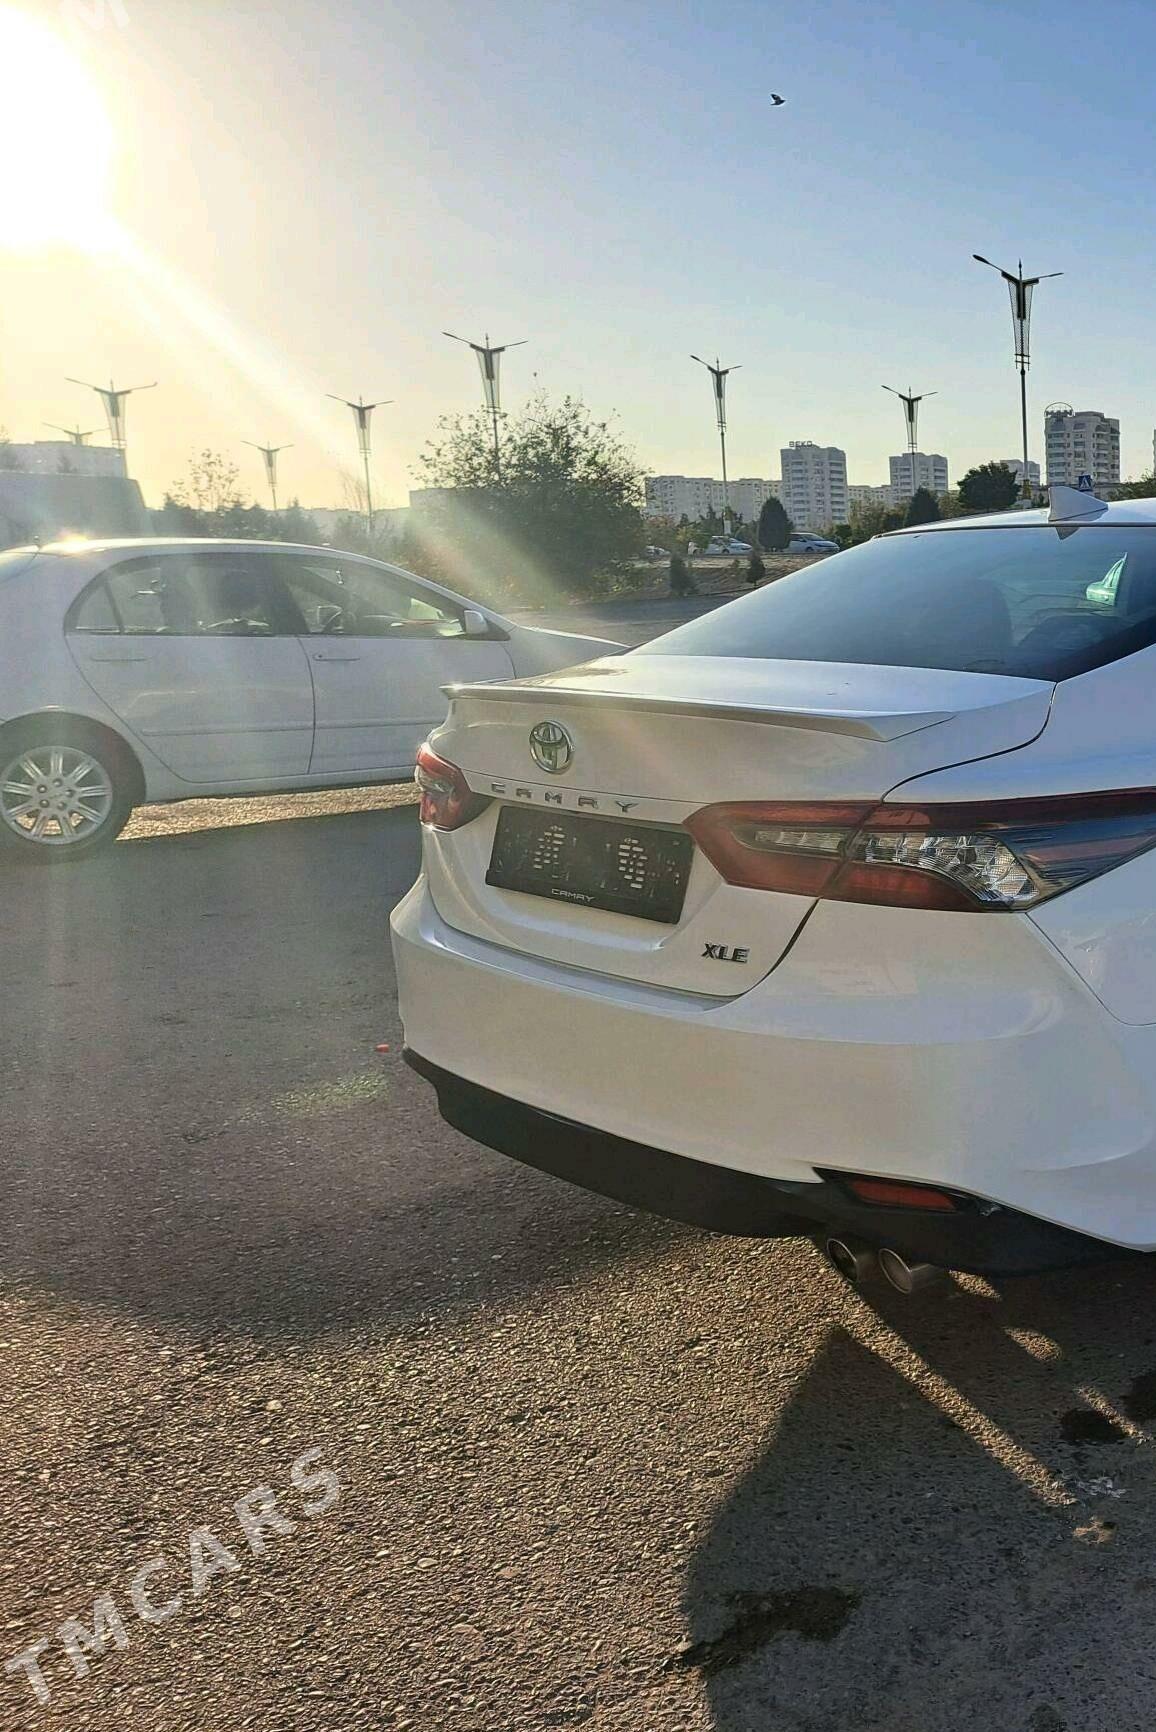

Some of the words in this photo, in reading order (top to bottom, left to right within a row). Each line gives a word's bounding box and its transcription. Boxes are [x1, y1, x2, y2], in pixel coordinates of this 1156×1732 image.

[490, 781, 640, 813] CAMRY
[551, 888, 596, 903] CAMRY
[700, 942, 751, 964] XLE
